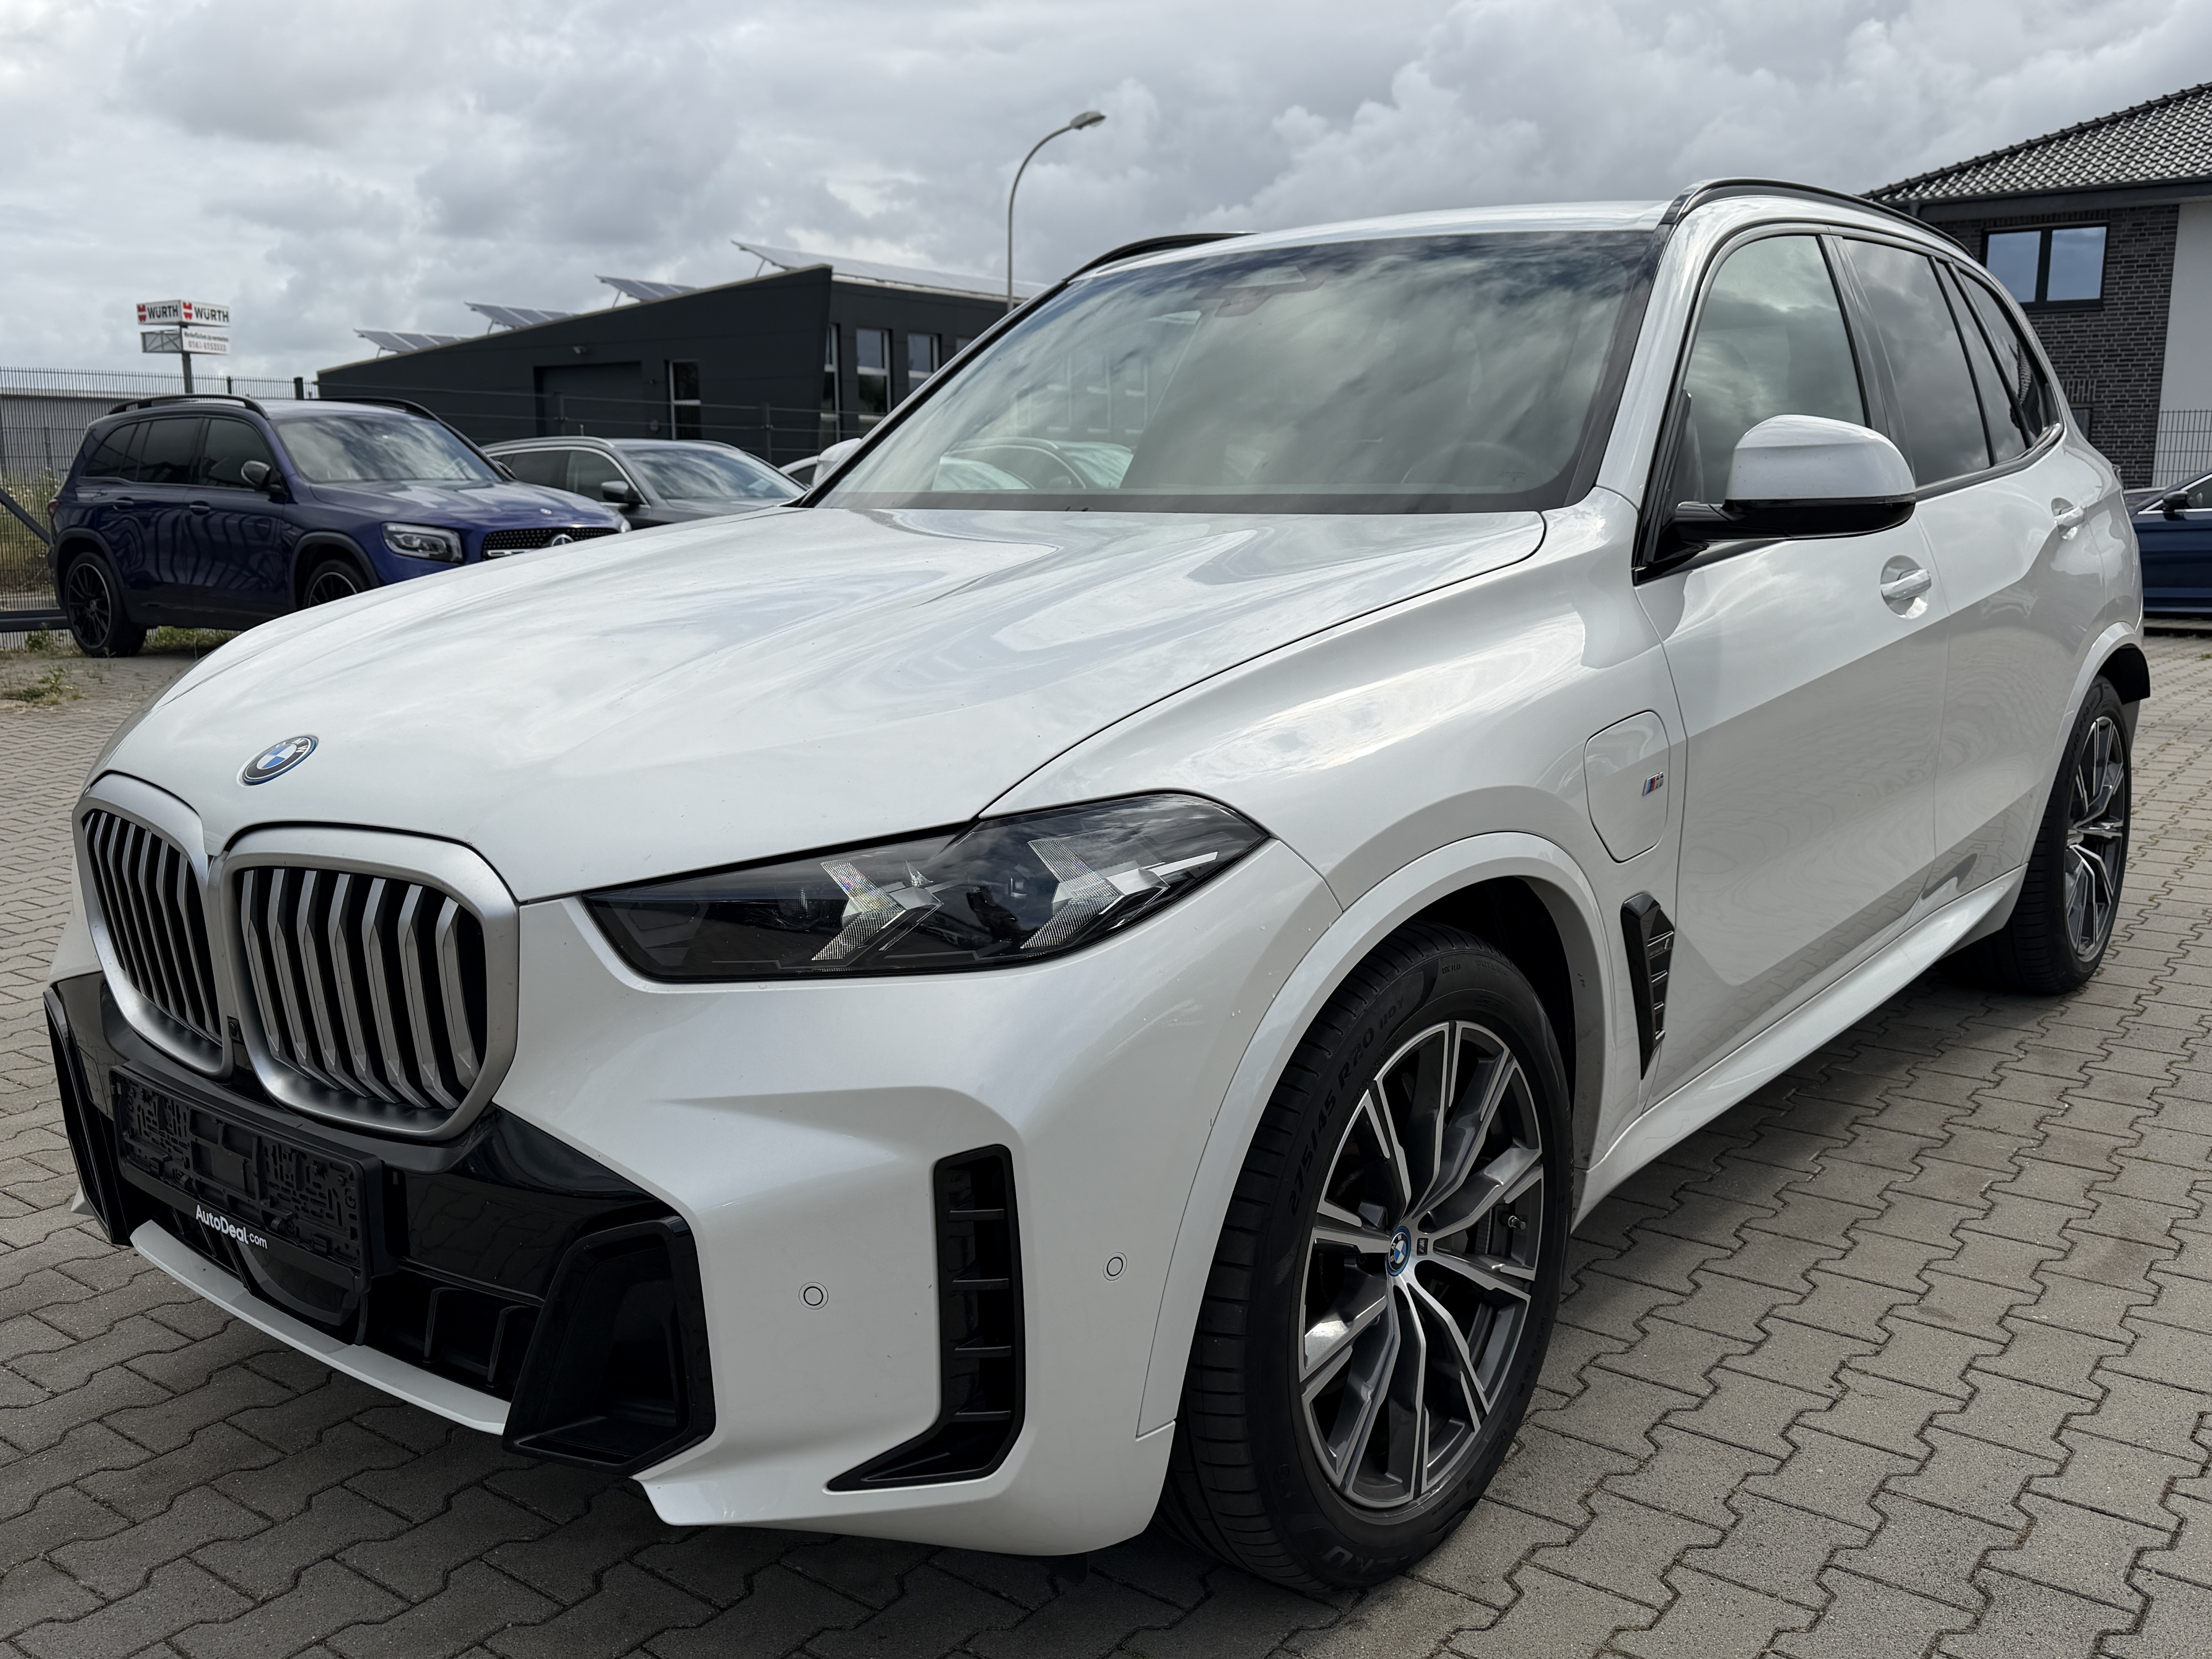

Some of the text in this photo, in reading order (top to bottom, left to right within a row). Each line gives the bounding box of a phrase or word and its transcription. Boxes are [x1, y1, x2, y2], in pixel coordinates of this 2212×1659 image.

[147, 305, 178, 319] WÜRTH
[194, 306, 229, 323] WÜRTH
[275, 738, 308, 752] BMW
[1288, 1089, 1336, 1217] 275/45
[1338, 1027, 1374, 1091] R20
